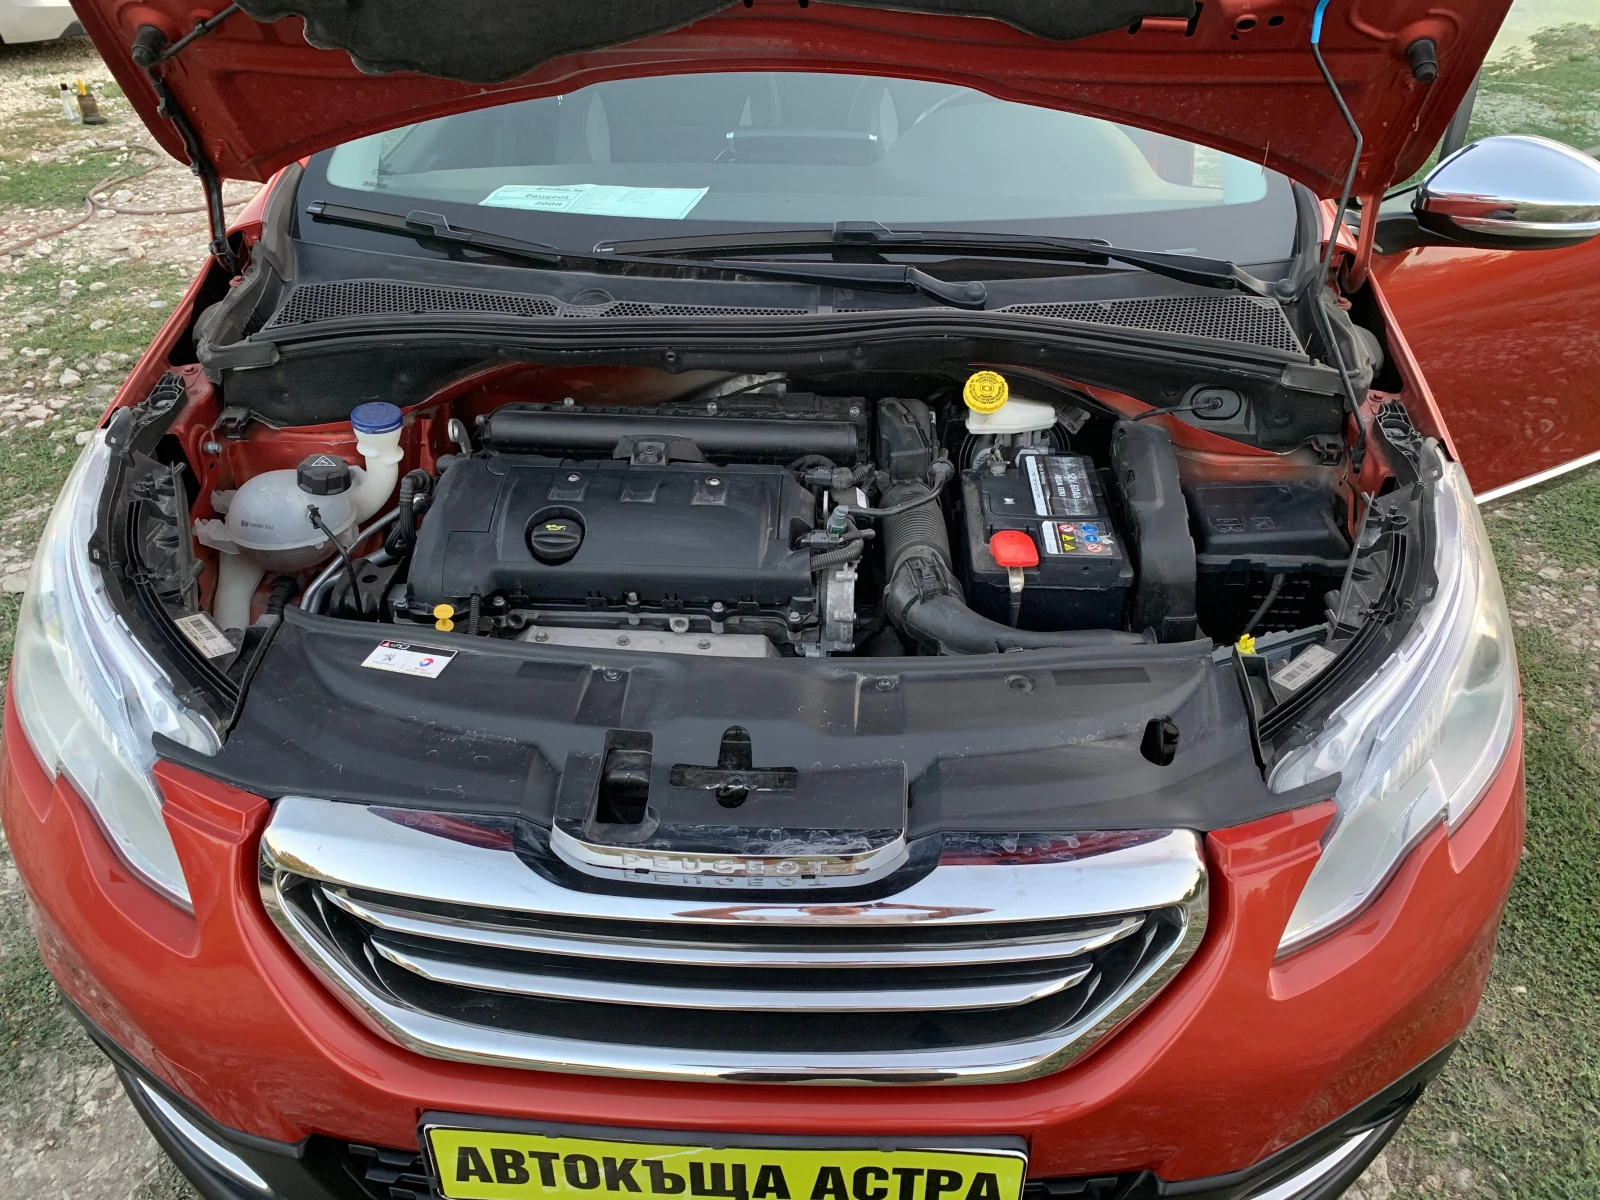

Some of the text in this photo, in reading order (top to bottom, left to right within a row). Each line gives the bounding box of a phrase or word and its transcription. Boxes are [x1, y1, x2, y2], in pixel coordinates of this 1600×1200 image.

[525, 193, 569, 201] Peugeot
[621, 853, 828, 876] PEUGEOT
[456, 1146, 1001, 1200] АВТОКЪЩА АСТРА
